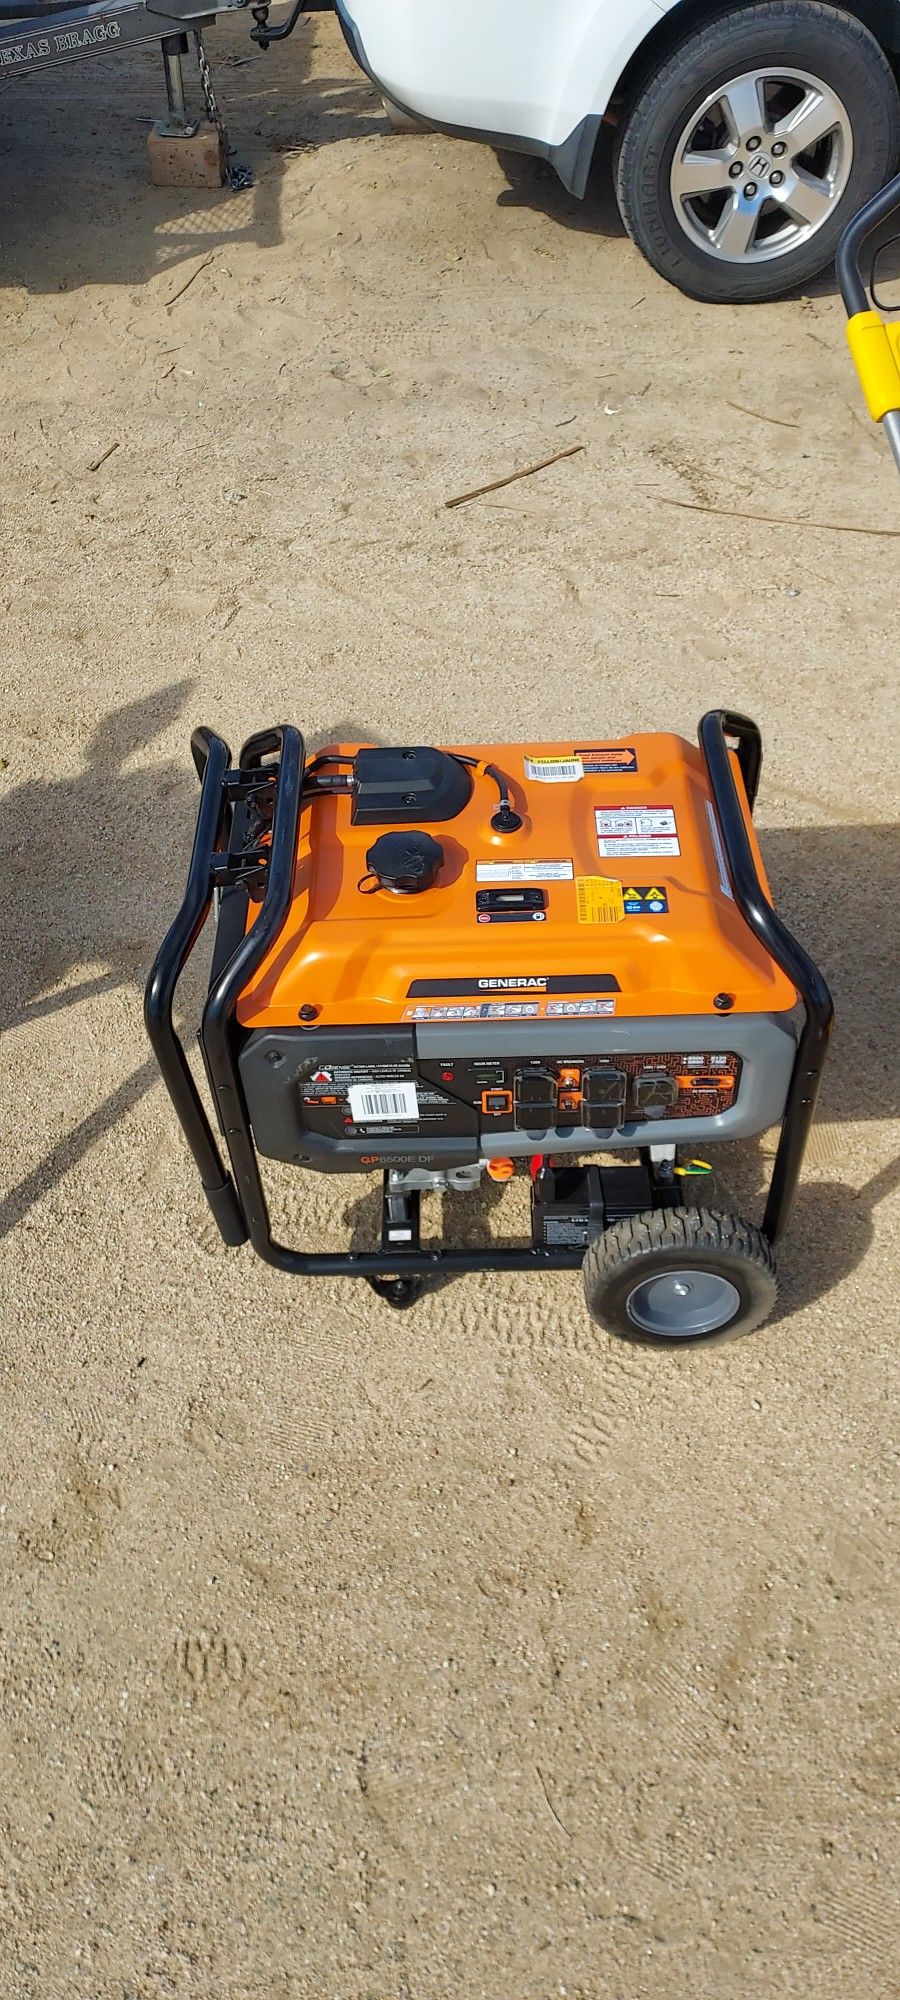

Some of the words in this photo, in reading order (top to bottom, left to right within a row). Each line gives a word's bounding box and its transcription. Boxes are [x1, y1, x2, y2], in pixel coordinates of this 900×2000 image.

[0, 39, 50, 66] EXAS
[54, 21, 121, 52] BRAGG
[478, 977, 547, 988] GENERAC
